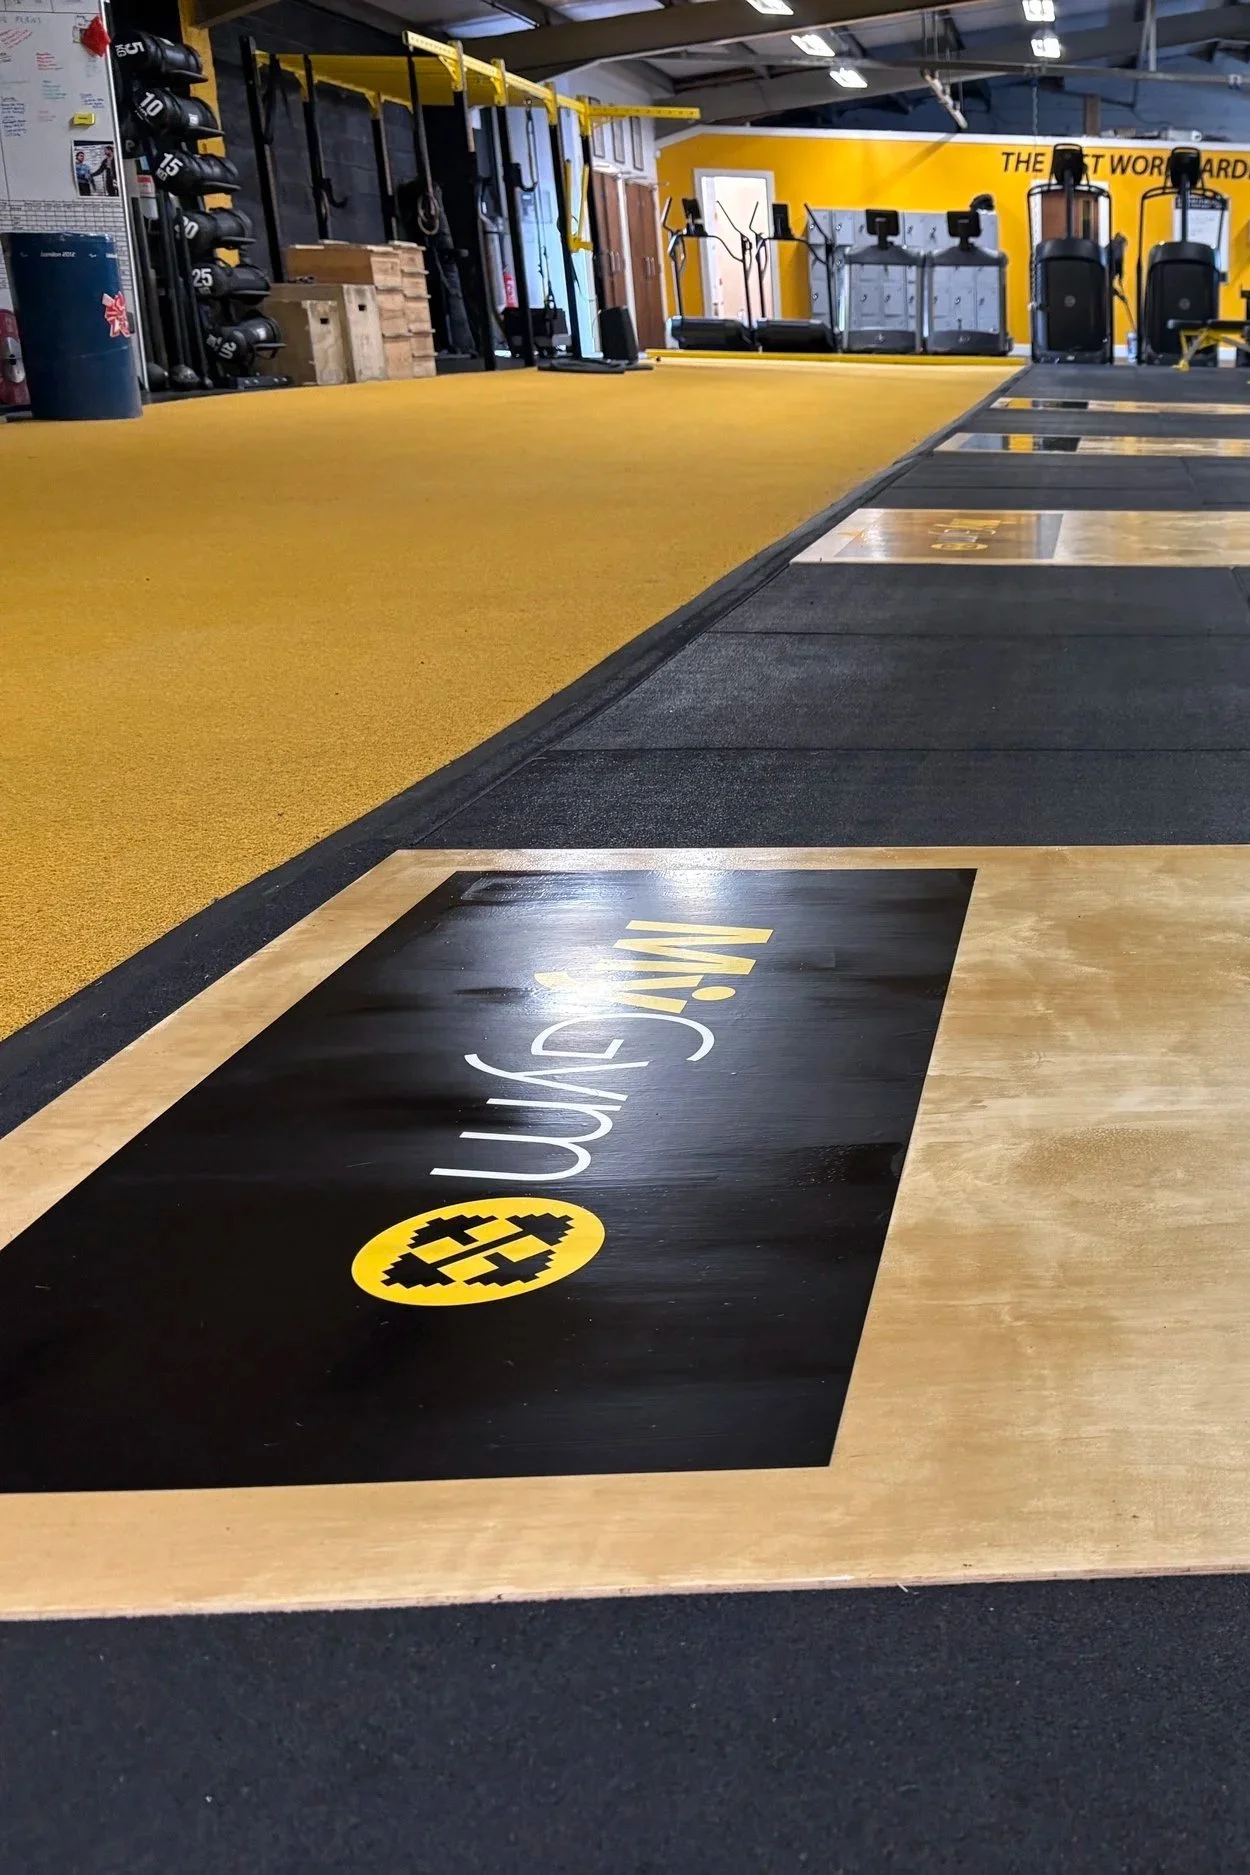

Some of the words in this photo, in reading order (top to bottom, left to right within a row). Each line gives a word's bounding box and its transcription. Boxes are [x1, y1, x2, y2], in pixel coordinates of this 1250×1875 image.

[115, 44, 127, 58] KG
[124, 41, 145, 55] 5
[140, 91, 164, 117] 10
[159, 152, 184, 177] 15
[1001, 152, 1046, 173] THE
[1110, 154, 1165, 176] WOR
[192, 268, 213, 287] 25
